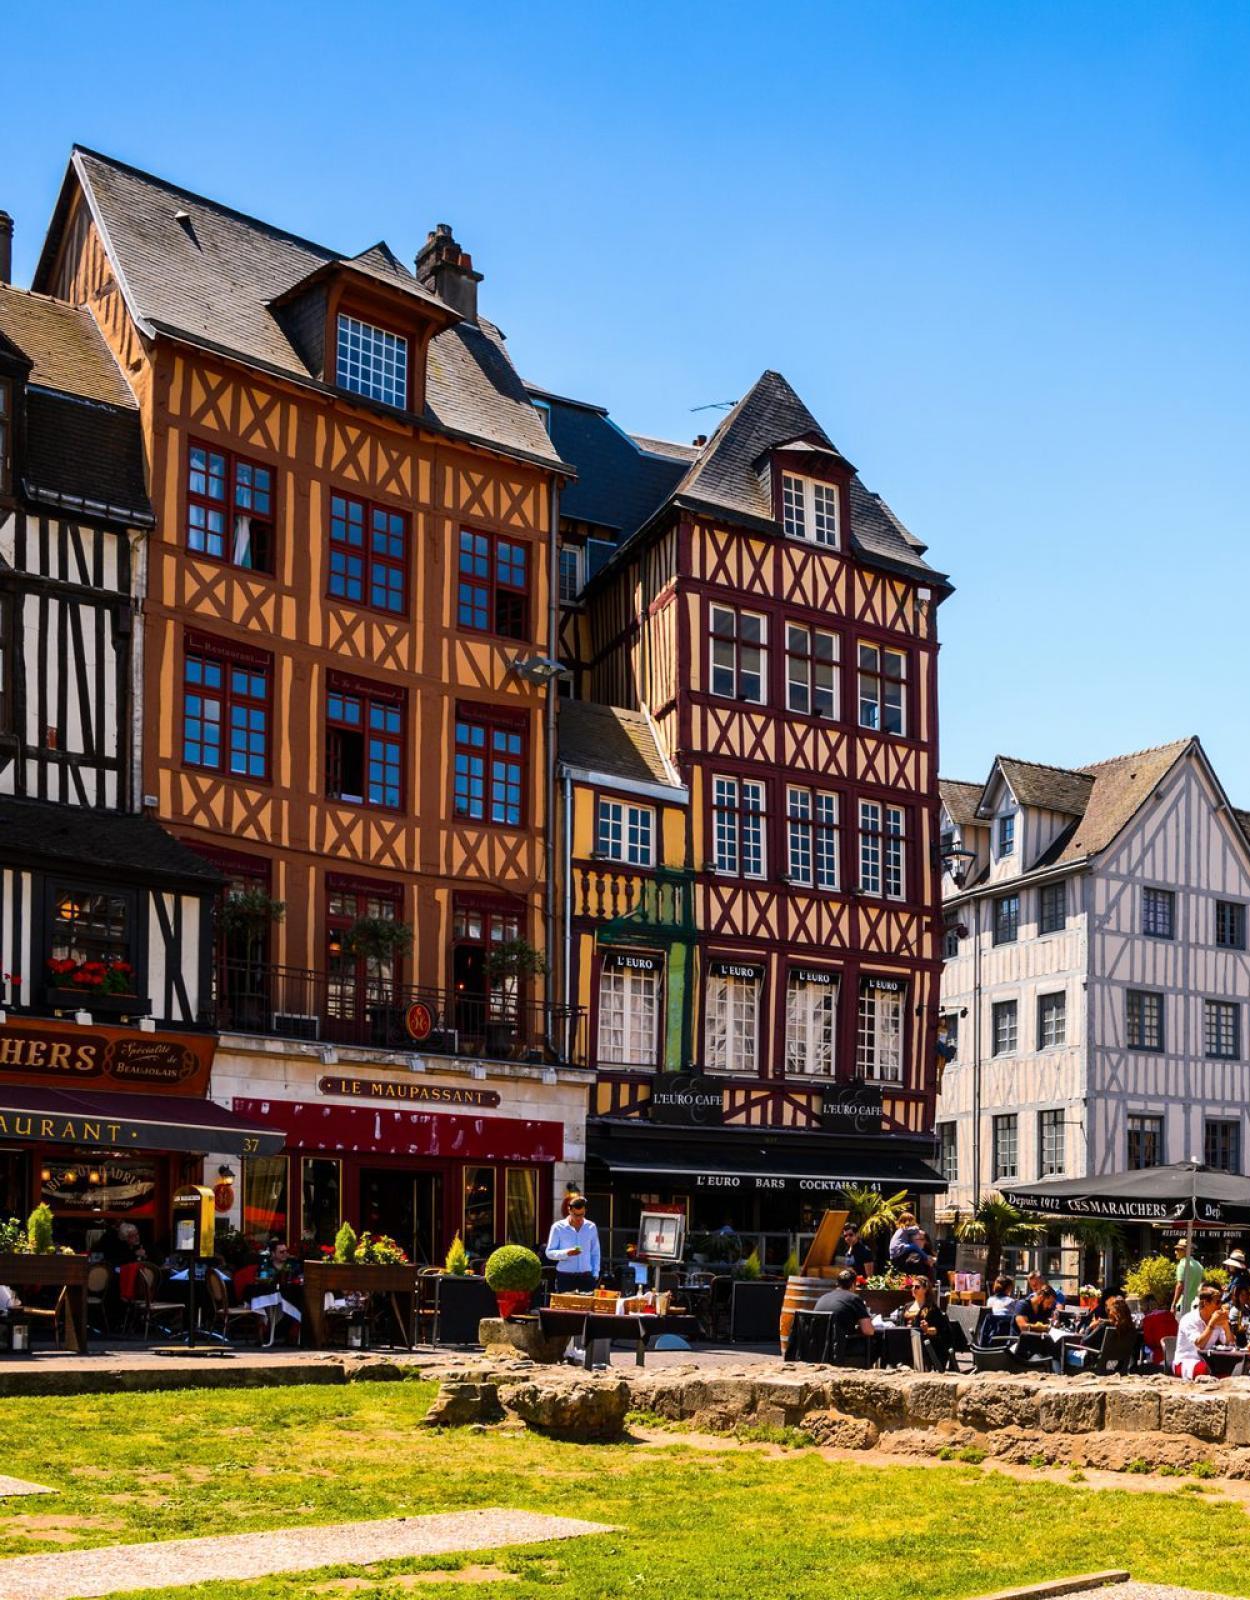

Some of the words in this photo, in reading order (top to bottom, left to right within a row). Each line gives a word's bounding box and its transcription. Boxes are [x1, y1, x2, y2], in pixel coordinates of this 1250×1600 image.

[341, 1080, 361, 1095] LE
[372, 1083, 482, 1105] MAUPASSANT
[244, 1138, 259, 1152] 37
[755, 1178, 785, 1188] BARS
[800, 1180, 858, 1191] COCKTAILS
[871, 1182, 882, 1191] 41
[1090, 1201, 1167, 1217] MARAICHERS
